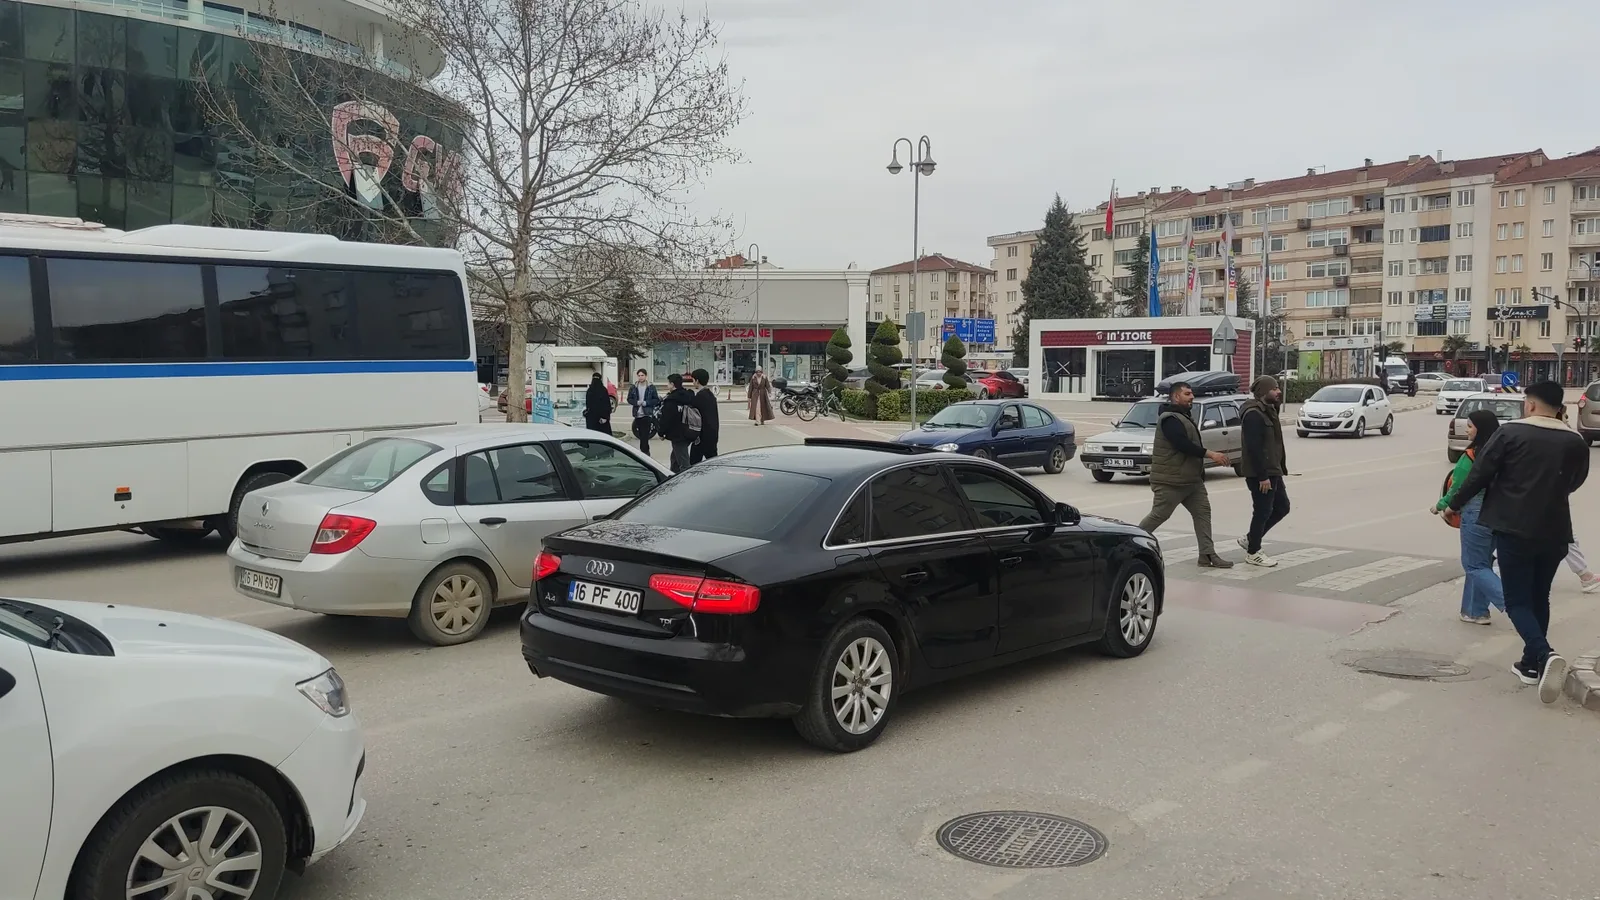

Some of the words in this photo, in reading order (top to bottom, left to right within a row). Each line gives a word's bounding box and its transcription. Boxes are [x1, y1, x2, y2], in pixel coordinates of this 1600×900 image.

[725, 328, 770, 338] ECZANE
[253, 573, 264, 588] PN
[264, 576, 279, 592] 697
[544, 592, 556, 602] A4
[574, 582, 586, 601] 16
[591, 586, 611, 605] PF
[614, 590, 639, 612] 400
